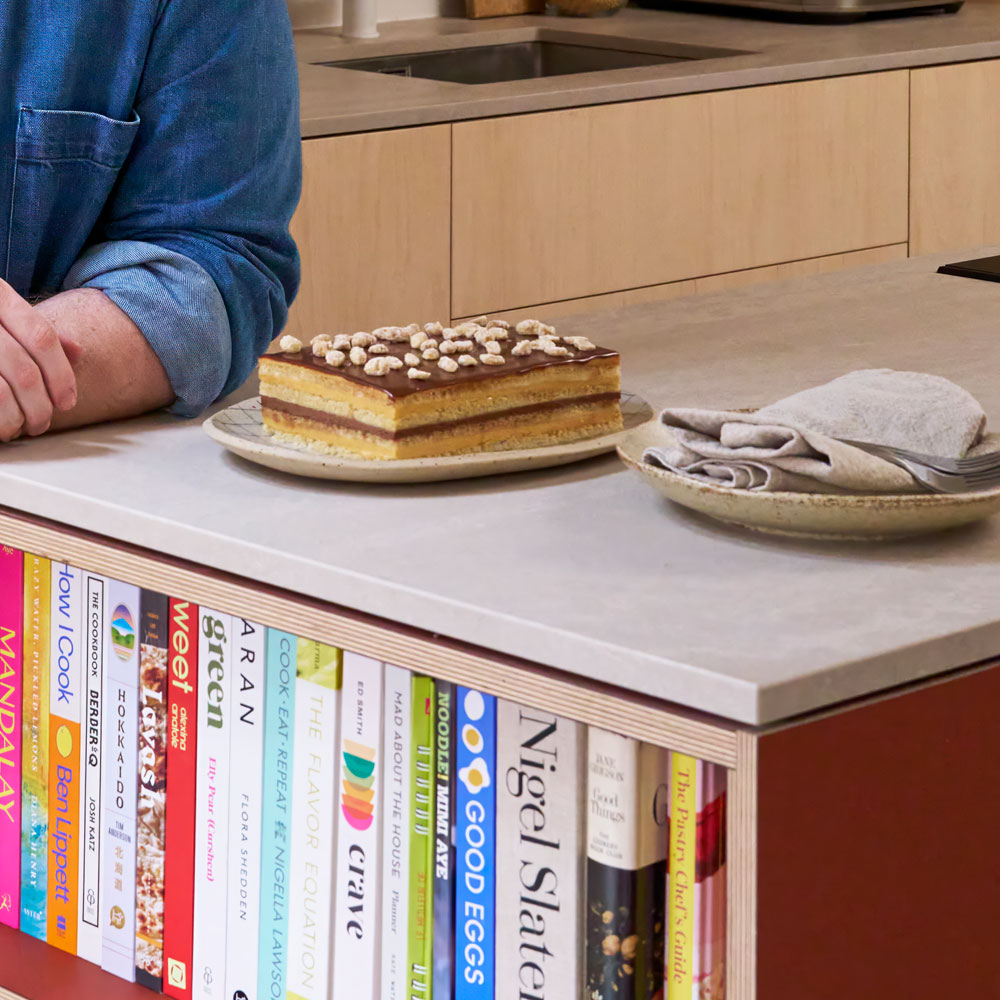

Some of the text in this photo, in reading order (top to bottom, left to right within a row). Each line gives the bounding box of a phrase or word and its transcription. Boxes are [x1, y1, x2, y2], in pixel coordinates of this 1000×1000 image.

[57, 635, 74, 704] Cook
[58, 624, 74, 633] I
[91, 591, 99, 677] THE COOKBOOK
[202, 615, 227, 730] green
[239, 618, 256, 726] ARAN
[31, 651, 40, 712] PICKLED
[171, 703, 179, 749] anatole
[357, 680, 364, 697] ED
[31, 716, 39, 772] LEMONS
[116, 688, 126, 809] HOKKAIDO
[139, 685, 163, 809] Lavash
[179, 706, 187, 751] alexina
[437, 691, 450, 781] NOODLE!
[591, 763, 625, 783] GRIGSON
[595, 752, 617, 768] JANE
[88, 797, 96, 824] JOSH
[206, 757, 217, 883] Elly Pear (Curshen)
[391, 691, 403, 878] MAD ABOUT THE HOUSE
[505, 709, 560, 850] Nigel
[591, 799, 625, 824] Things
[593, 787, 618, 807] Good
[30, 795, 38, 888] DIANA HENRY
[51, 764, 73, 904] Ben Lippett
[108, 827, 131, 844] ANDERSON
[115, 820, 124, 831] TIM
[239, 793, 249, 921] FLORA SHEDDEN
[301, 696, 323, 990] THE FLAVOR EQUATION
[436, 784, 449, 880] MIMI AYE
[346, 844, 365, 940] crave
[391, 890, 400, 935] Planner
[464, 800, 486, 985] GOOD EGGS
[673, 768, 691, 985] The Pastry Chef's Guide
[270, 846, 285, 1000] NIGELLA LAWSO
